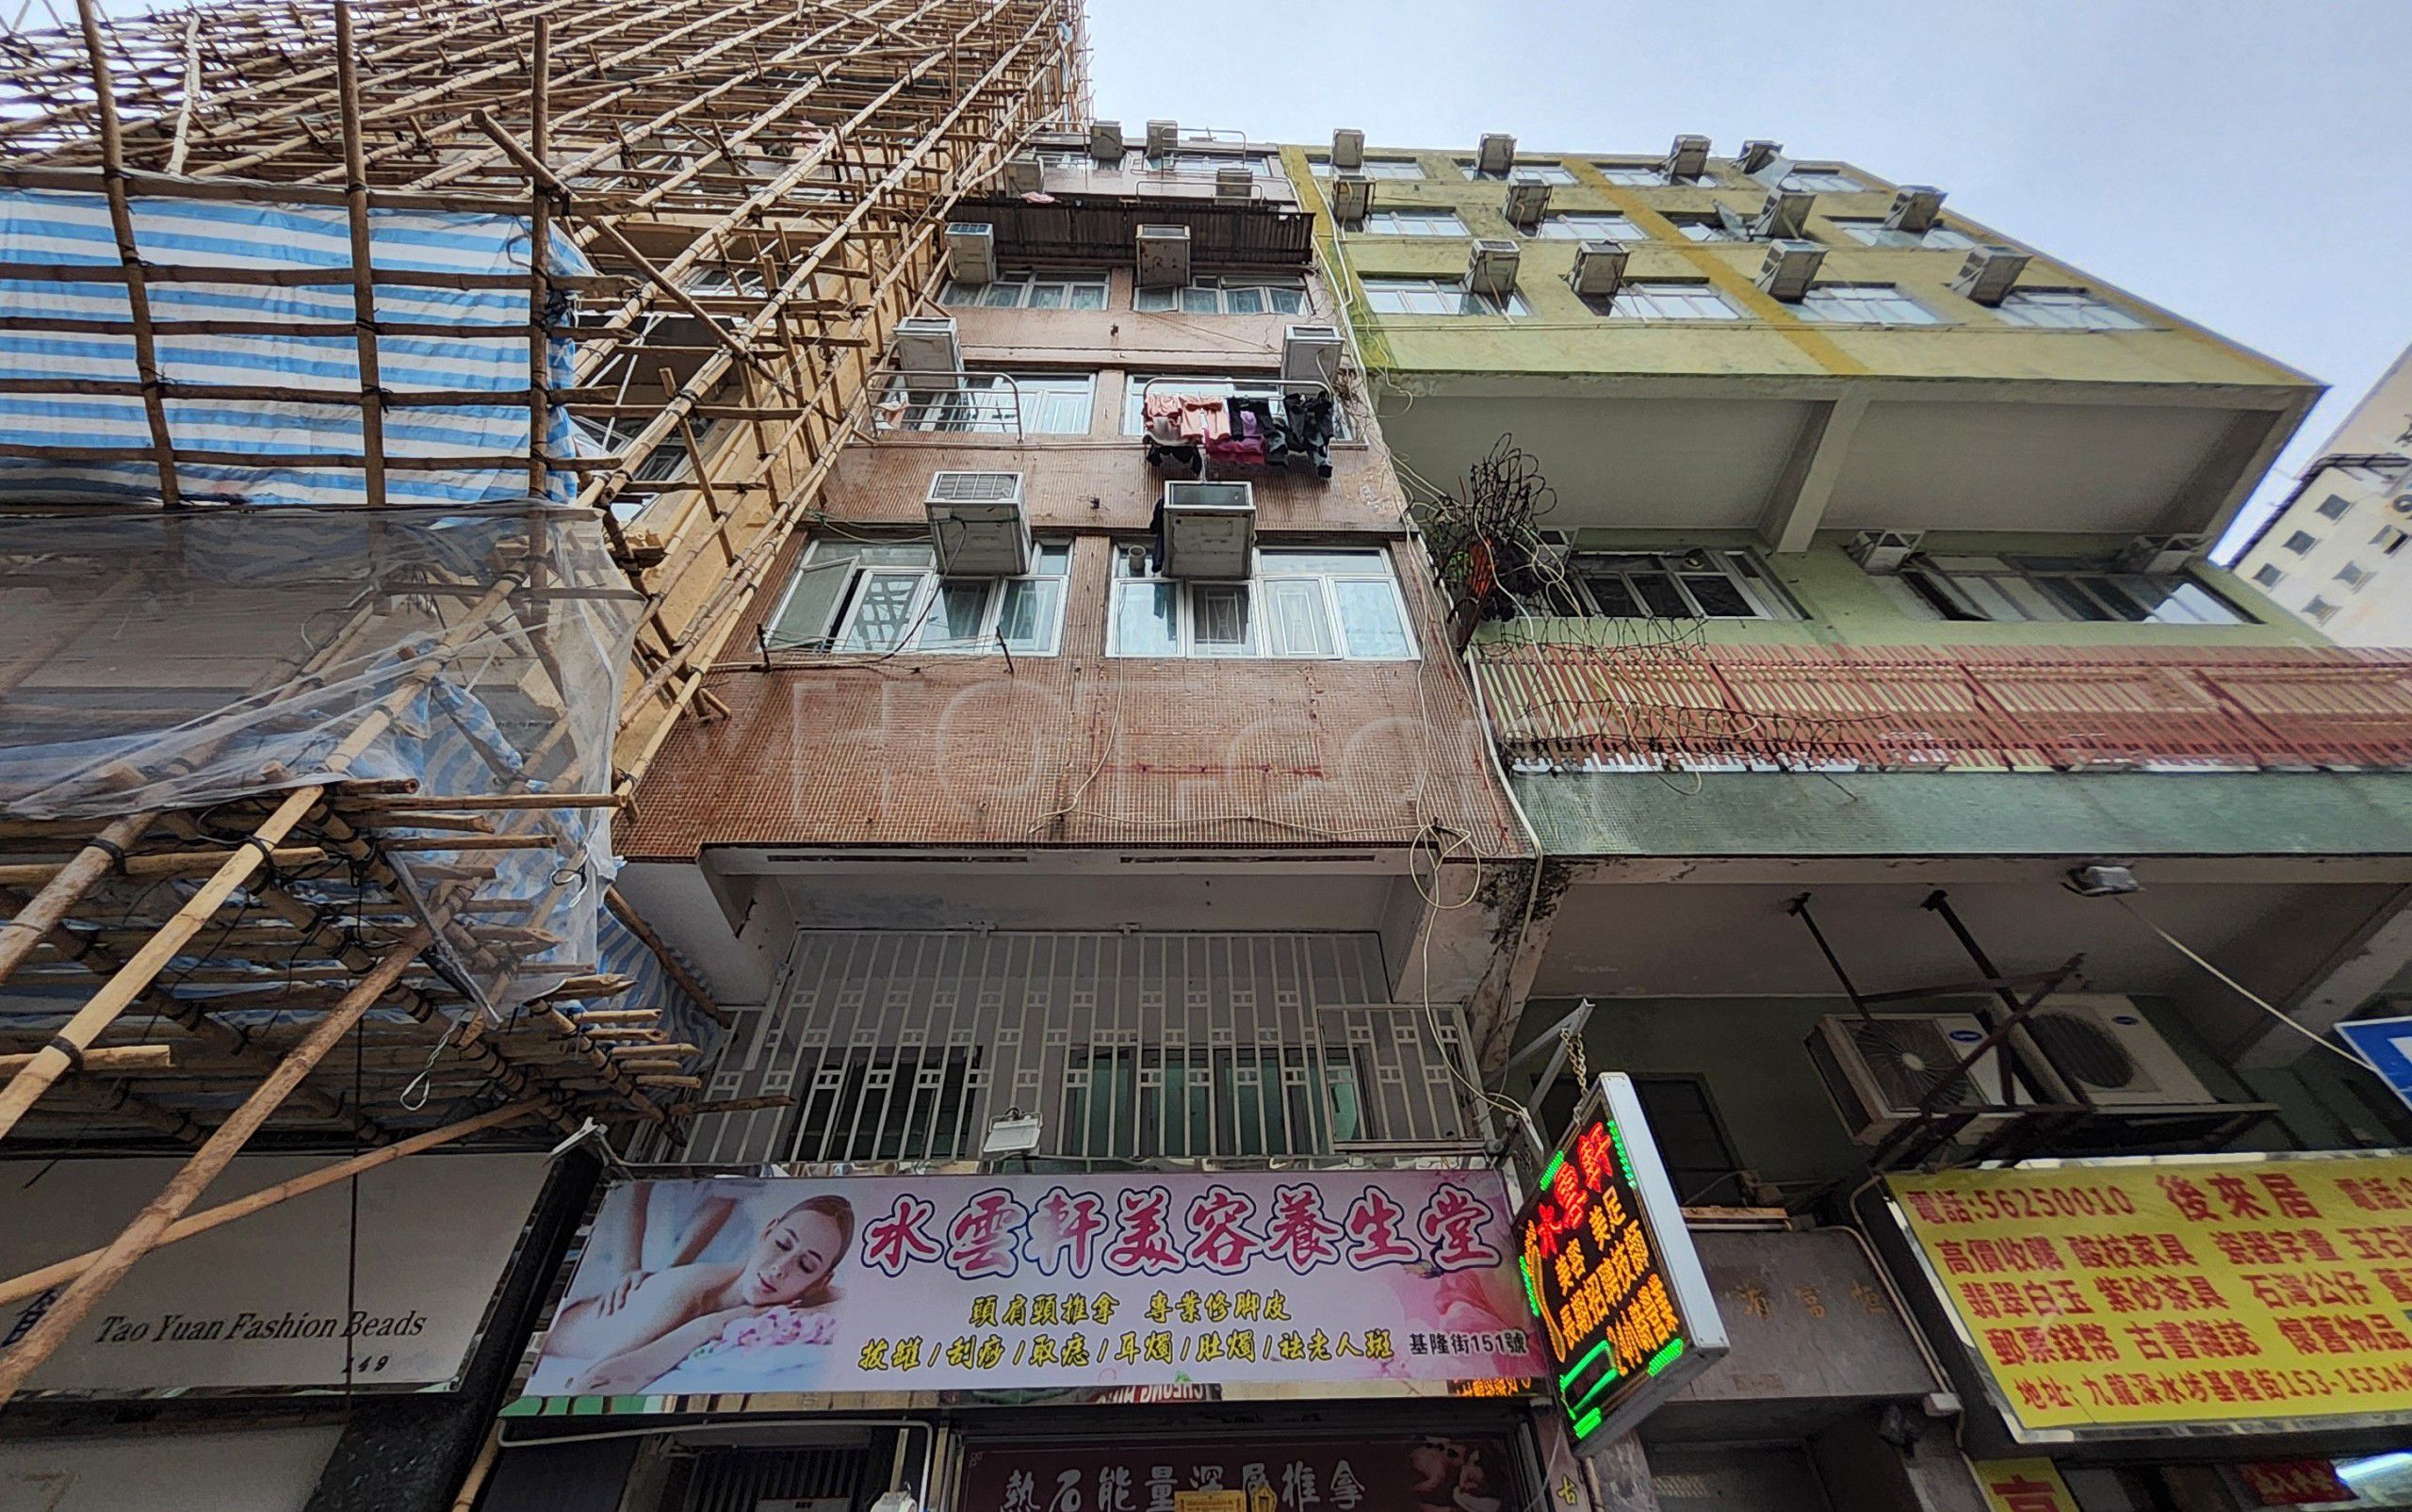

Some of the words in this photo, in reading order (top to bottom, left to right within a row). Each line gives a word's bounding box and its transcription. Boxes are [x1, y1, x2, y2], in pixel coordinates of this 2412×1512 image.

[1538, 1121, 1613, 1260] 水雲軒
[2156, 1172, 2322, 1222] 後來居
[861, 1182, 1502, 1280] 水雲軒美容養生堂
[1555, 1238, 1588, 1296] 美容
[1589, 1185, 1627, 1252] 美足
[1934, 1236, 2066, 1276] 高價收購
[2063, 1232, 2199, 1270] 酸枝家具
[2208, 1227, 2343, 1265] 瓷器字畫
[2337, 1225, 2412, 1260] 玉石
[1559, 1219, 1650, 1351] 長期招聘技師
[1959, 1279, 2094, 1320] 翡翠白玉
[2094, 1274, 2231, 1314] 紫砂茶具
[2240, 1270, 2373, 1309] 石灣公仔
[94, 1315, 148, 1343] Tao
[153, 1314, 225, 1341] Yuan
[224, 1310, 337, 1341] Fashion
[339, 1310, 427, 1338] Beads
[1410, 1331, 1528, 1357] 基隆街151號
[1983, 1323, 2121, 1366] 郵票錢幣
[2124, 1317, 2262, 1360] 古書雜誌
